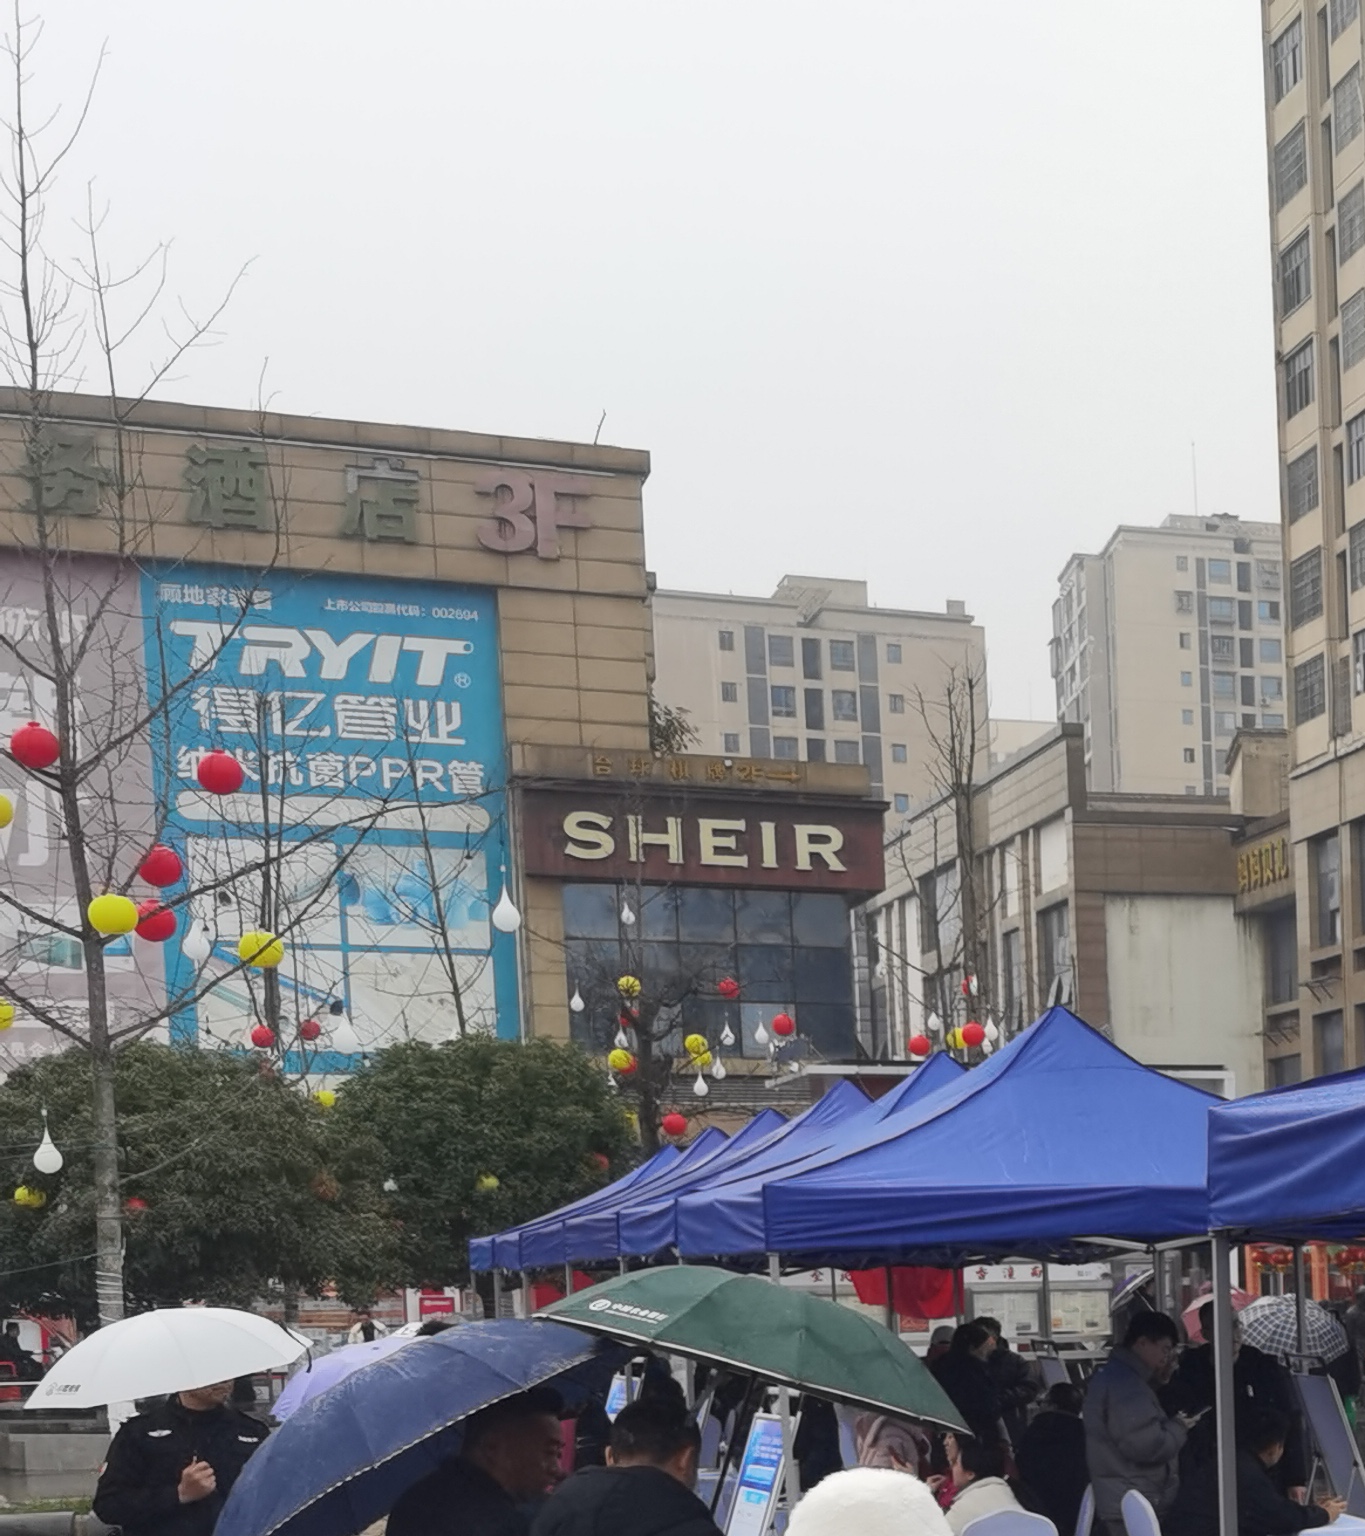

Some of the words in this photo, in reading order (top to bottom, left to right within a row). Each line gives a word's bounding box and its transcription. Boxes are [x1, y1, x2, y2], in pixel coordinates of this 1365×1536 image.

[475, 470, 592, 561] 3F
[169, 618, 474, 687] TRYIT
[562, 810, 848, 872] SHEIR
